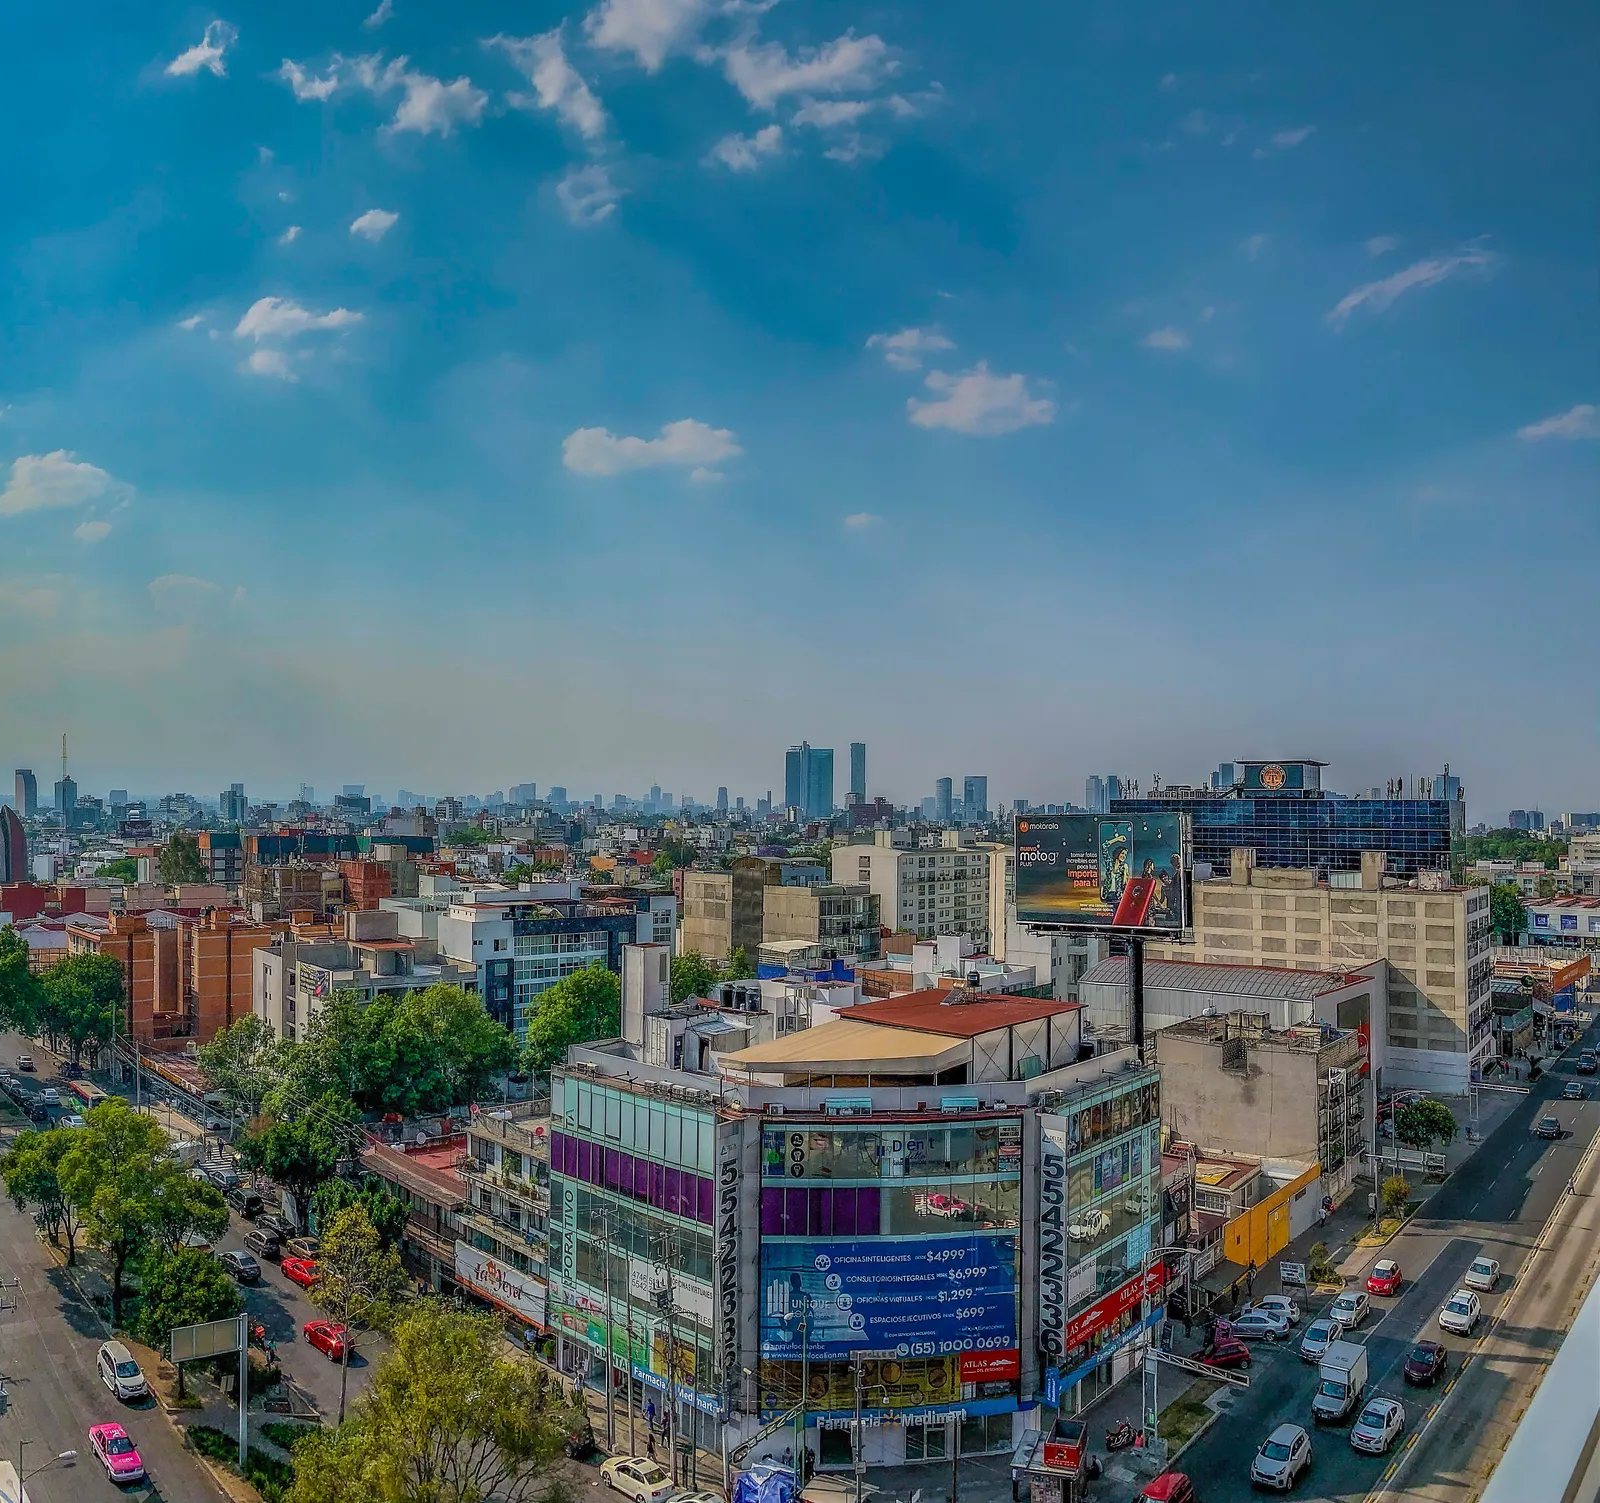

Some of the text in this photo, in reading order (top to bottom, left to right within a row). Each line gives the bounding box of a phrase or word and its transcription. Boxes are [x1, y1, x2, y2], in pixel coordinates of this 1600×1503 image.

[1092, 879, 1097, 887] ti
[927, 1249, 965, 1263] $4,999
[949, 1267, 987, 1280] $6,999
[631, 1280, 647, 1292] 5542
[1120, 1283, 1138, 1302] ATLAS
[890, 1295, 923, 1303] VIRTUALES
[938, 1288, 973, 1303] $1,299
[956, 1306, 985, 1320] $699
[911, 1335, 1010, 1356] (55) 1000 0699
[963, 1360, 988, 1368] ATLAS
[634, 1366, 666, 1390] Farmacia
[901, 1408, 967, 1427] Medimart
